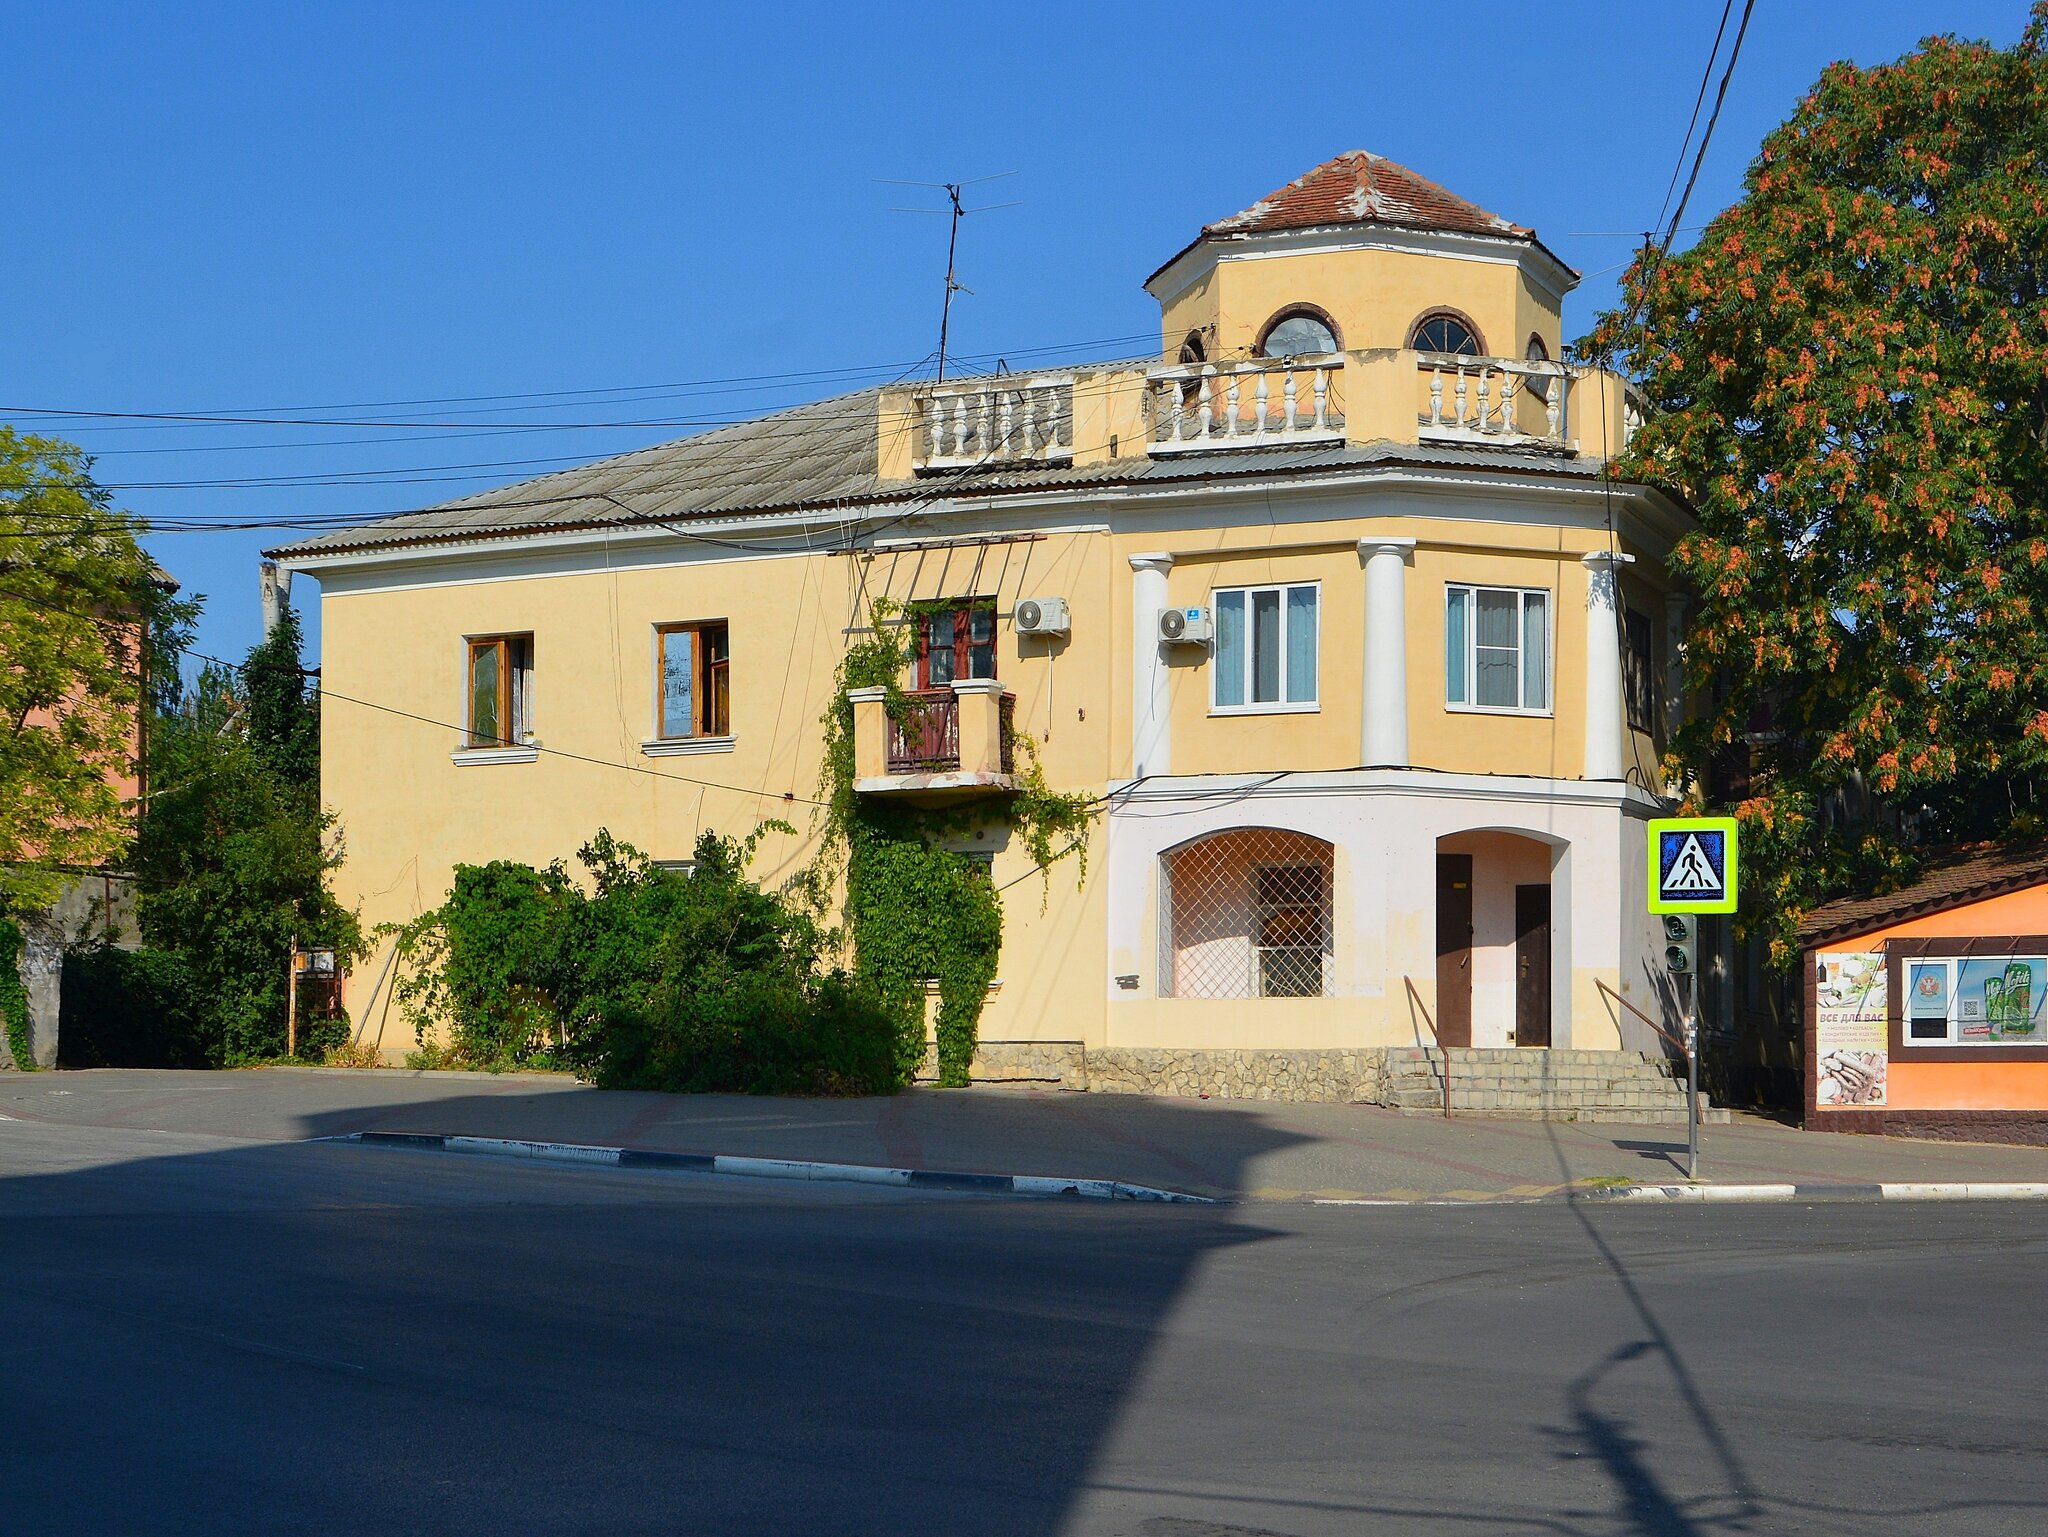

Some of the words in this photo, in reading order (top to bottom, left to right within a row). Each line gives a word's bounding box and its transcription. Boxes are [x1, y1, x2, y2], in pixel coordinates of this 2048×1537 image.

[1820, 1013, 1838, 1022] ВСЕ
[1840, 1013, 1861, 1023] ДЛЯ
[1864, 1013, 1884, 1022] ВАС
